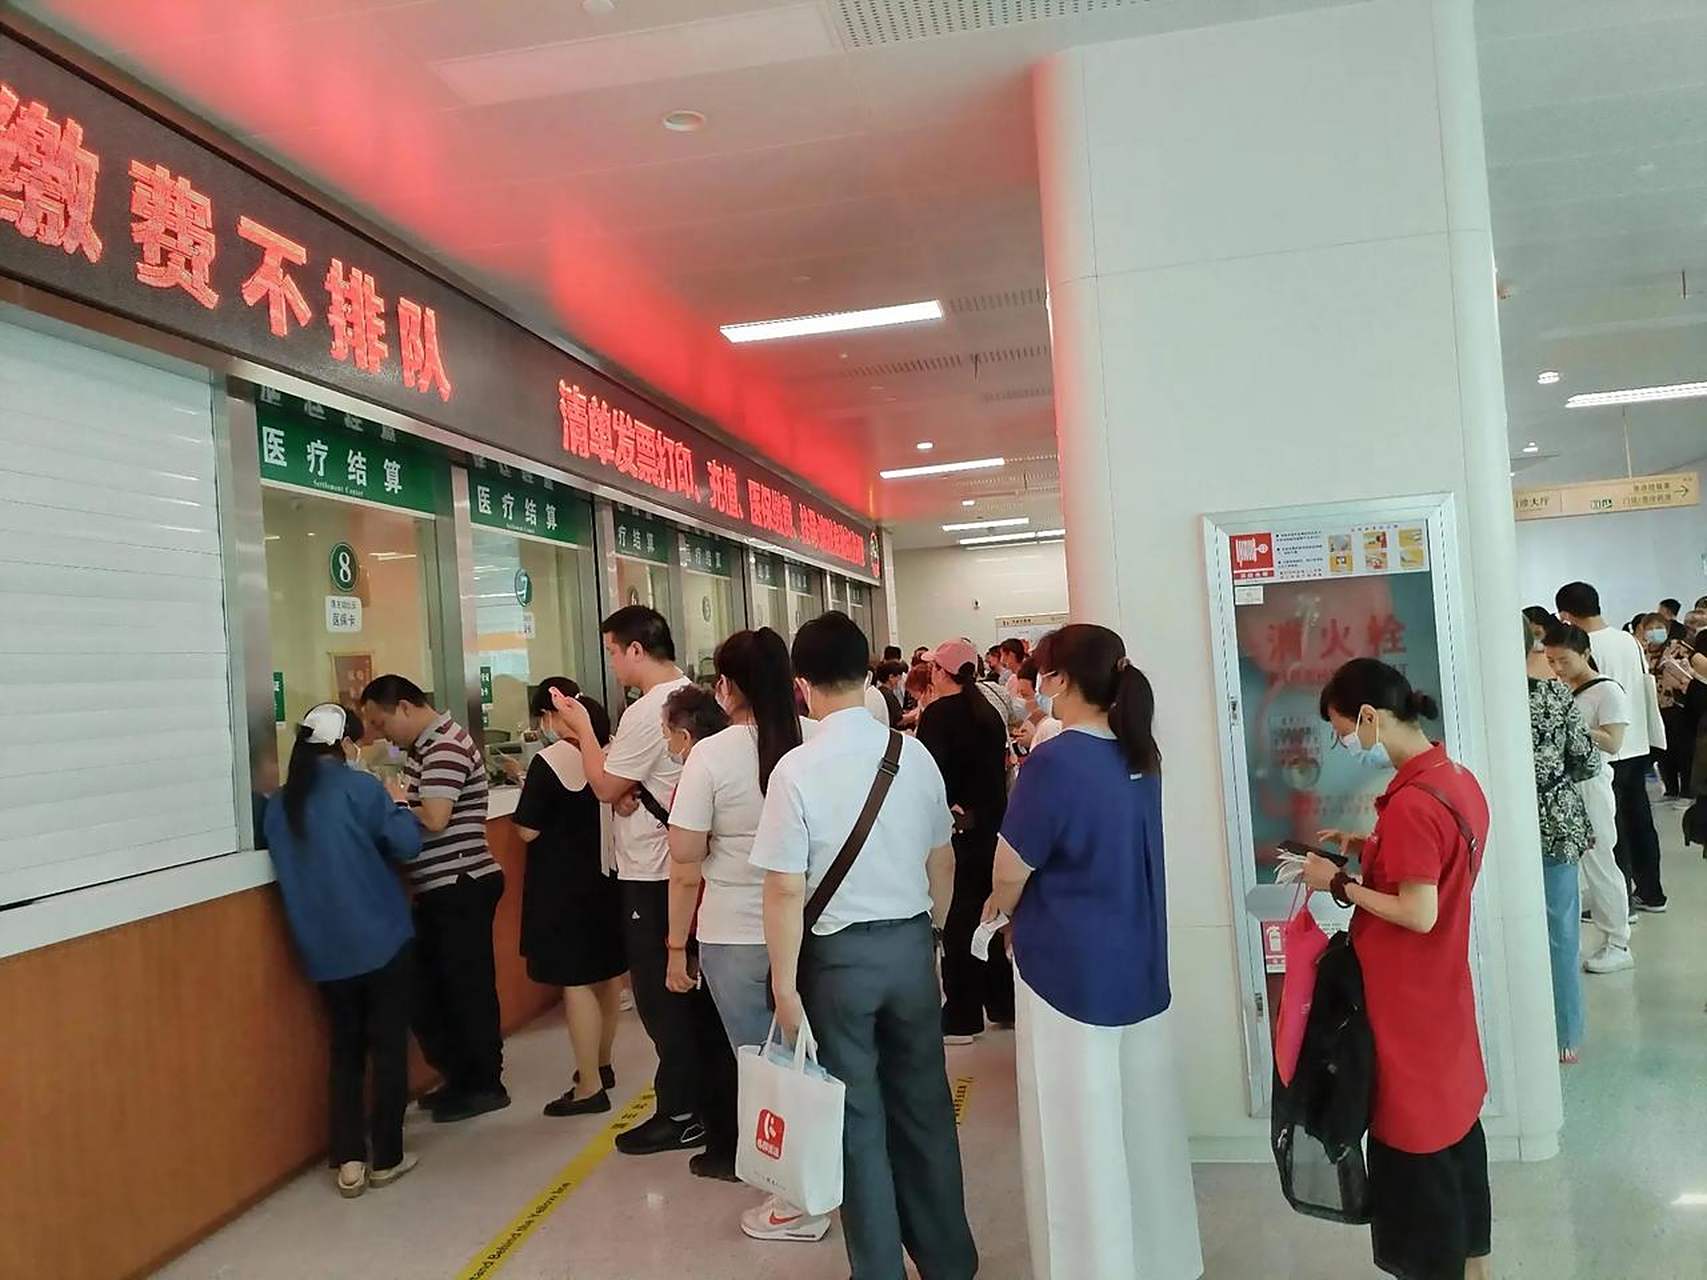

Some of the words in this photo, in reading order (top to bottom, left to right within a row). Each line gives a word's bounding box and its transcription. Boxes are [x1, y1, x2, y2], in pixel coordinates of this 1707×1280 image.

[261, 426, 403, 494] 医疗结算
[477, 484, 557, 530] 医疗结算
[339, 550, 352, 583] 8
[1268, 613, 1408, 663] 消火栓
